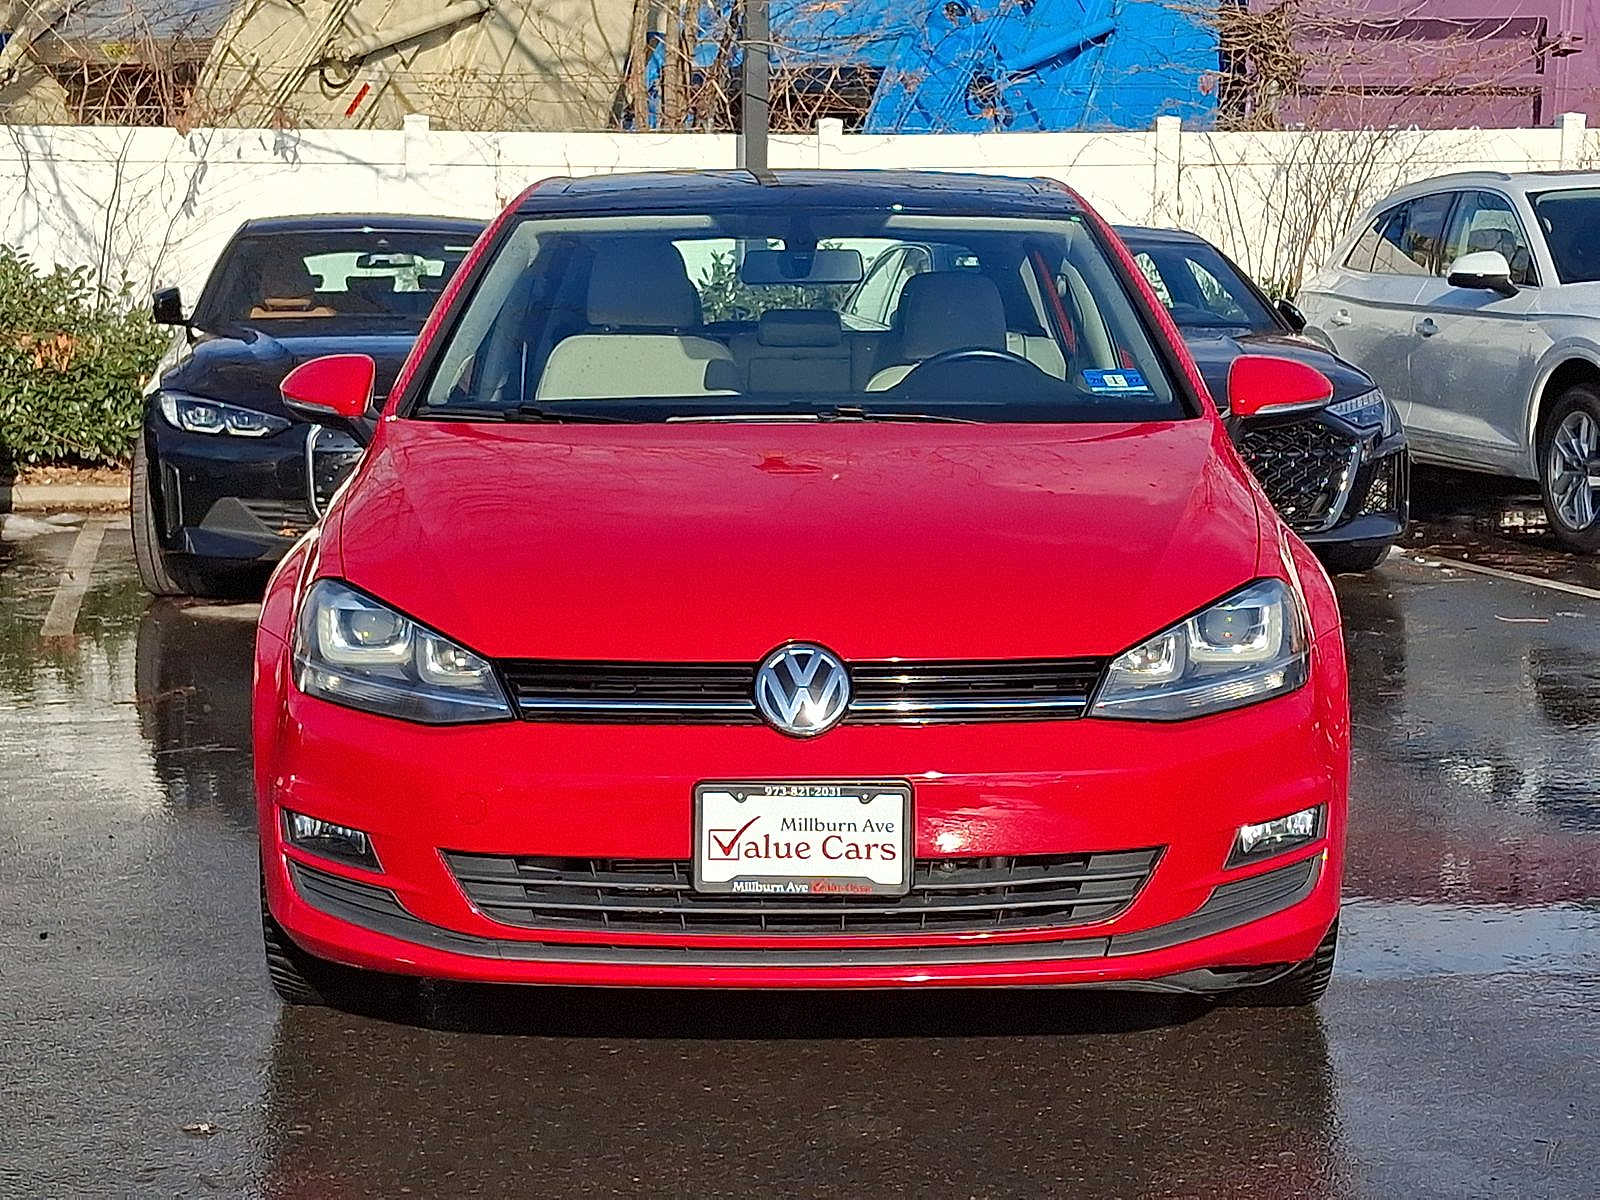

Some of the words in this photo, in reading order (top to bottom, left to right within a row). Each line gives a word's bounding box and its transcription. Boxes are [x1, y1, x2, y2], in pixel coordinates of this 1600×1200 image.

[764, 786, 841, 796] 973-821-2031
[780, 817, 857, 833] Millburn
[862, 818, 894, 833] Ave
[822, 835, 896, 860] Cars
[732, 881, 784, 893] Millburn
[787, 882, 809, 893] Ave
